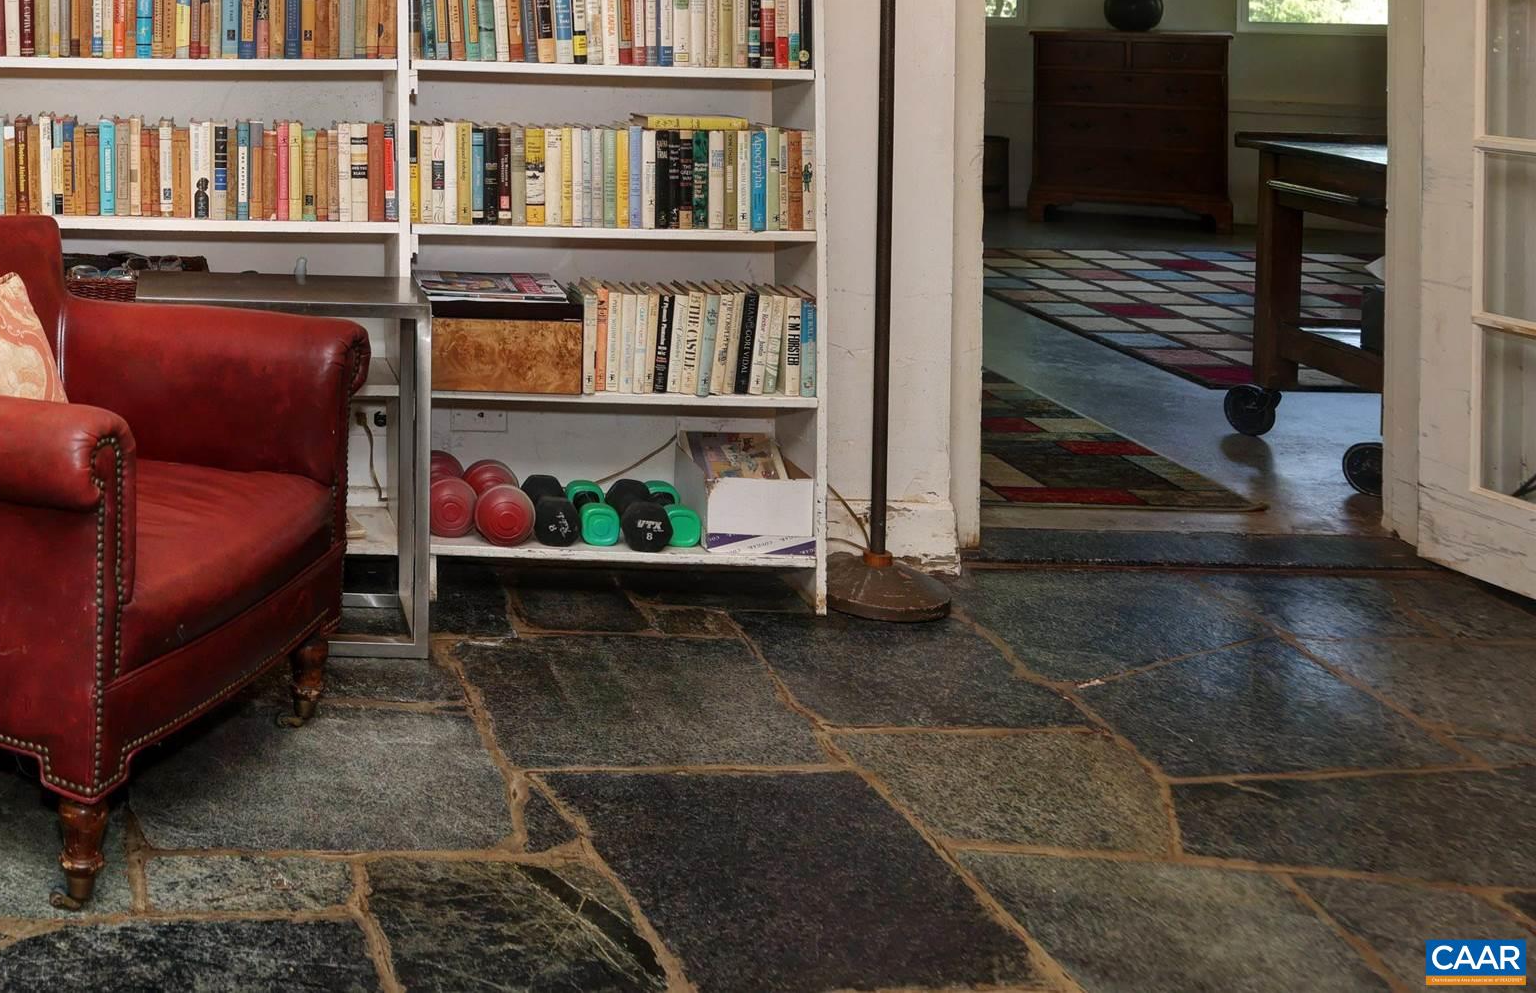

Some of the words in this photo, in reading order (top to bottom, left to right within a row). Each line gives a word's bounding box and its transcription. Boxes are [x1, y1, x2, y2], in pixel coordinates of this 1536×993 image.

[18, 143, 26, 164] Sholom
[753, 137, 764, 188] Apocrypha
[18, 165, 26, 192] Aleichem
[688, 305, 700, 327] THE
[684, 329, 698, 371] CASTLE
[646, 532, 653, 541] 8
